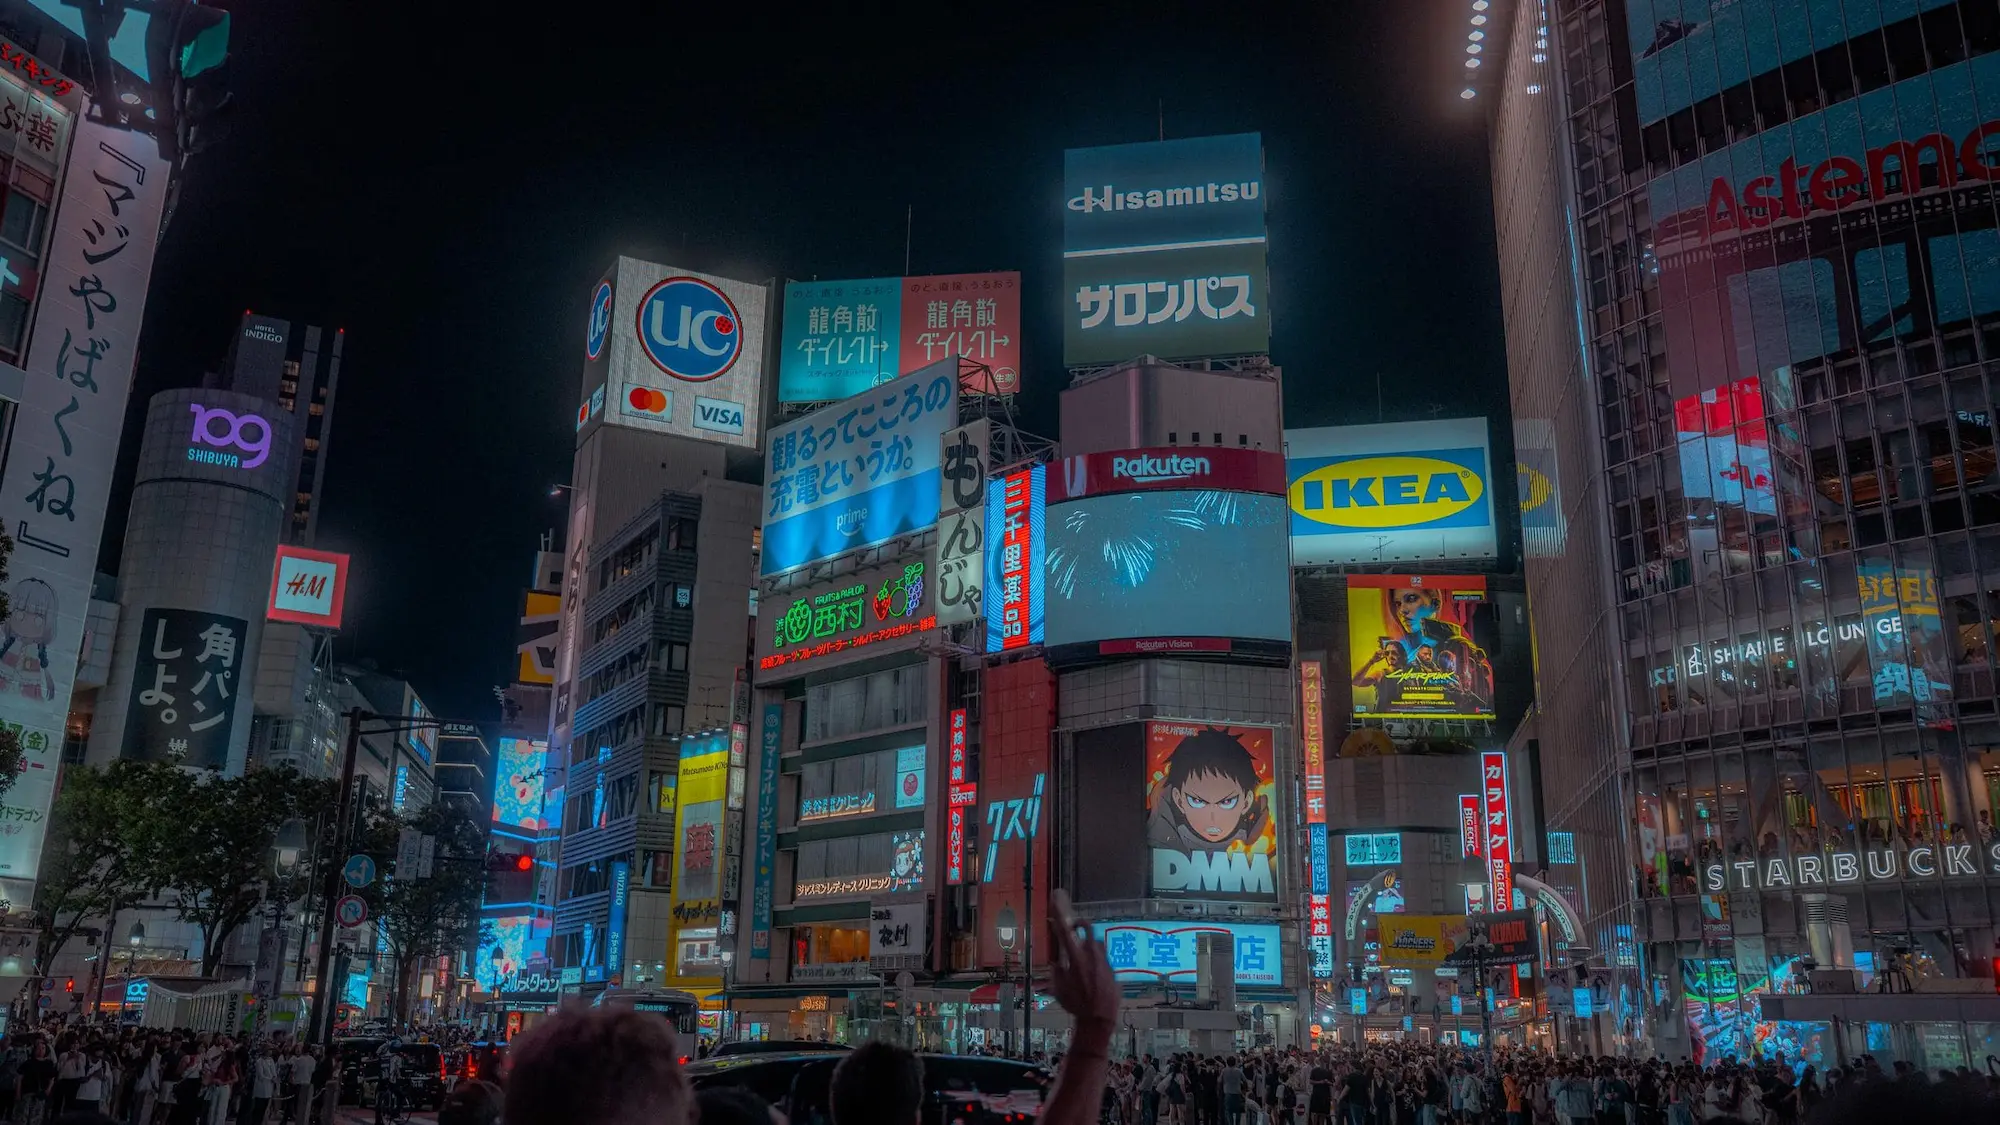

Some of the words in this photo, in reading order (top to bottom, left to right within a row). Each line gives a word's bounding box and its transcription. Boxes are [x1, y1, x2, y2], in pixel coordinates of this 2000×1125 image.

[1067, 181, 1259, 213] Hisamitsu
[927, 298, 997, 329] 龍角散
[1076, 275, 1255, 329] サロンパス
[245, 329, 283, 343] INDIGO
[254, 324, 276, 333] HOTEL
[651, 299, 731, 357] UC
[808, 304, 878, 335] 龍角散
[797, 335, 888, 367] ダイレクト
[916, 330, 1009, 361] ダイレクト
[698, 404, 742, 427] VISA
[772, 376, 952, 475] 観るってこころの
[190, 403, 272, 469] 109
[187, 448, 239, 468] SHIBUYA
[769, 434, 914, 516] 充電というか。
[1113, 453, 1211, 480] Rakuten
[1303, 472, 1471, 510] IKEA
[836, 508, 868, 531] prime
[942, 430, 984, 613] もんじゃ
[1003, 479, 1023, 638] 三千里薬品
[286, 572, 327, 599] H&M
[1136, 640, 1168, 651] Rakuten
[1169, 639, 1193, 650] Vision
[190, 622, 236, 732] 角パン
[760, 731, 778, 862] サマーフルーツギフト
[1307, 775, 1324, 815] 三千
[1486, 765, 1506, 848] カラオケ
[1153, 848, 1275, 894] DMM
[1493, 858, 1505, 879] BIG
[616, 870, 626, 905] MIZUHO
[1495, 880, 1507, 913] ECHO
[1109, 932, 1266, 971] 盛堂店
